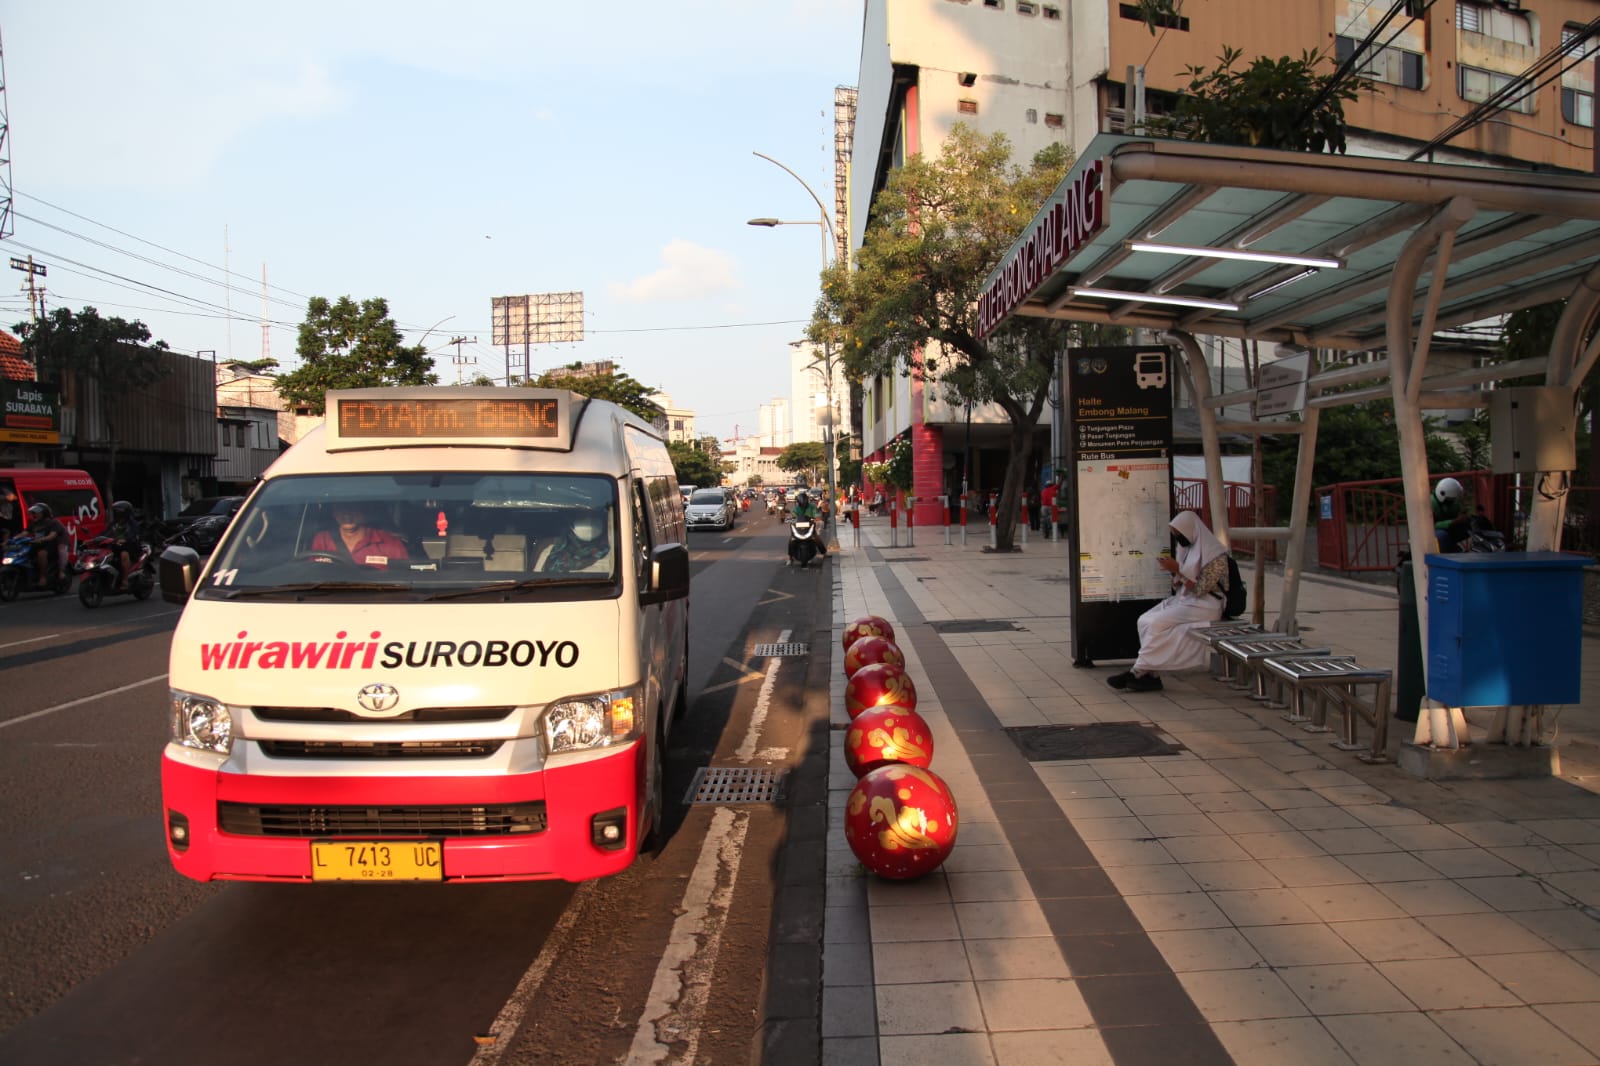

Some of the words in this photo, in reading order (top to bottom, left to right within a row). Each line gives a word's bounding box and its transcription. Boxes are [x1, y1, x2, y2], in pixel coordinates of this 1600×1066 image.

[1034, 159, 1102, 284] MALANG
[17, 387, 43, 403] Lapis
[1078, 397, 1102, 406] Halte
[5, 401, 53, 415] SURABAYA
[1079, 407, 1115, 417] Embong
[1117, 406, 1149, 416] Malang
[1100, 452, 1115, 460] Bus
[212, 568, 238, 586] 11
[200, 630, 382, 671] wirawiri
[380, 640, 580, 670] SUROBOYO
[315, 847, 328, 867] L
[345, 846, 391, 867] 7413
[413, 846, 439, 867] UC
